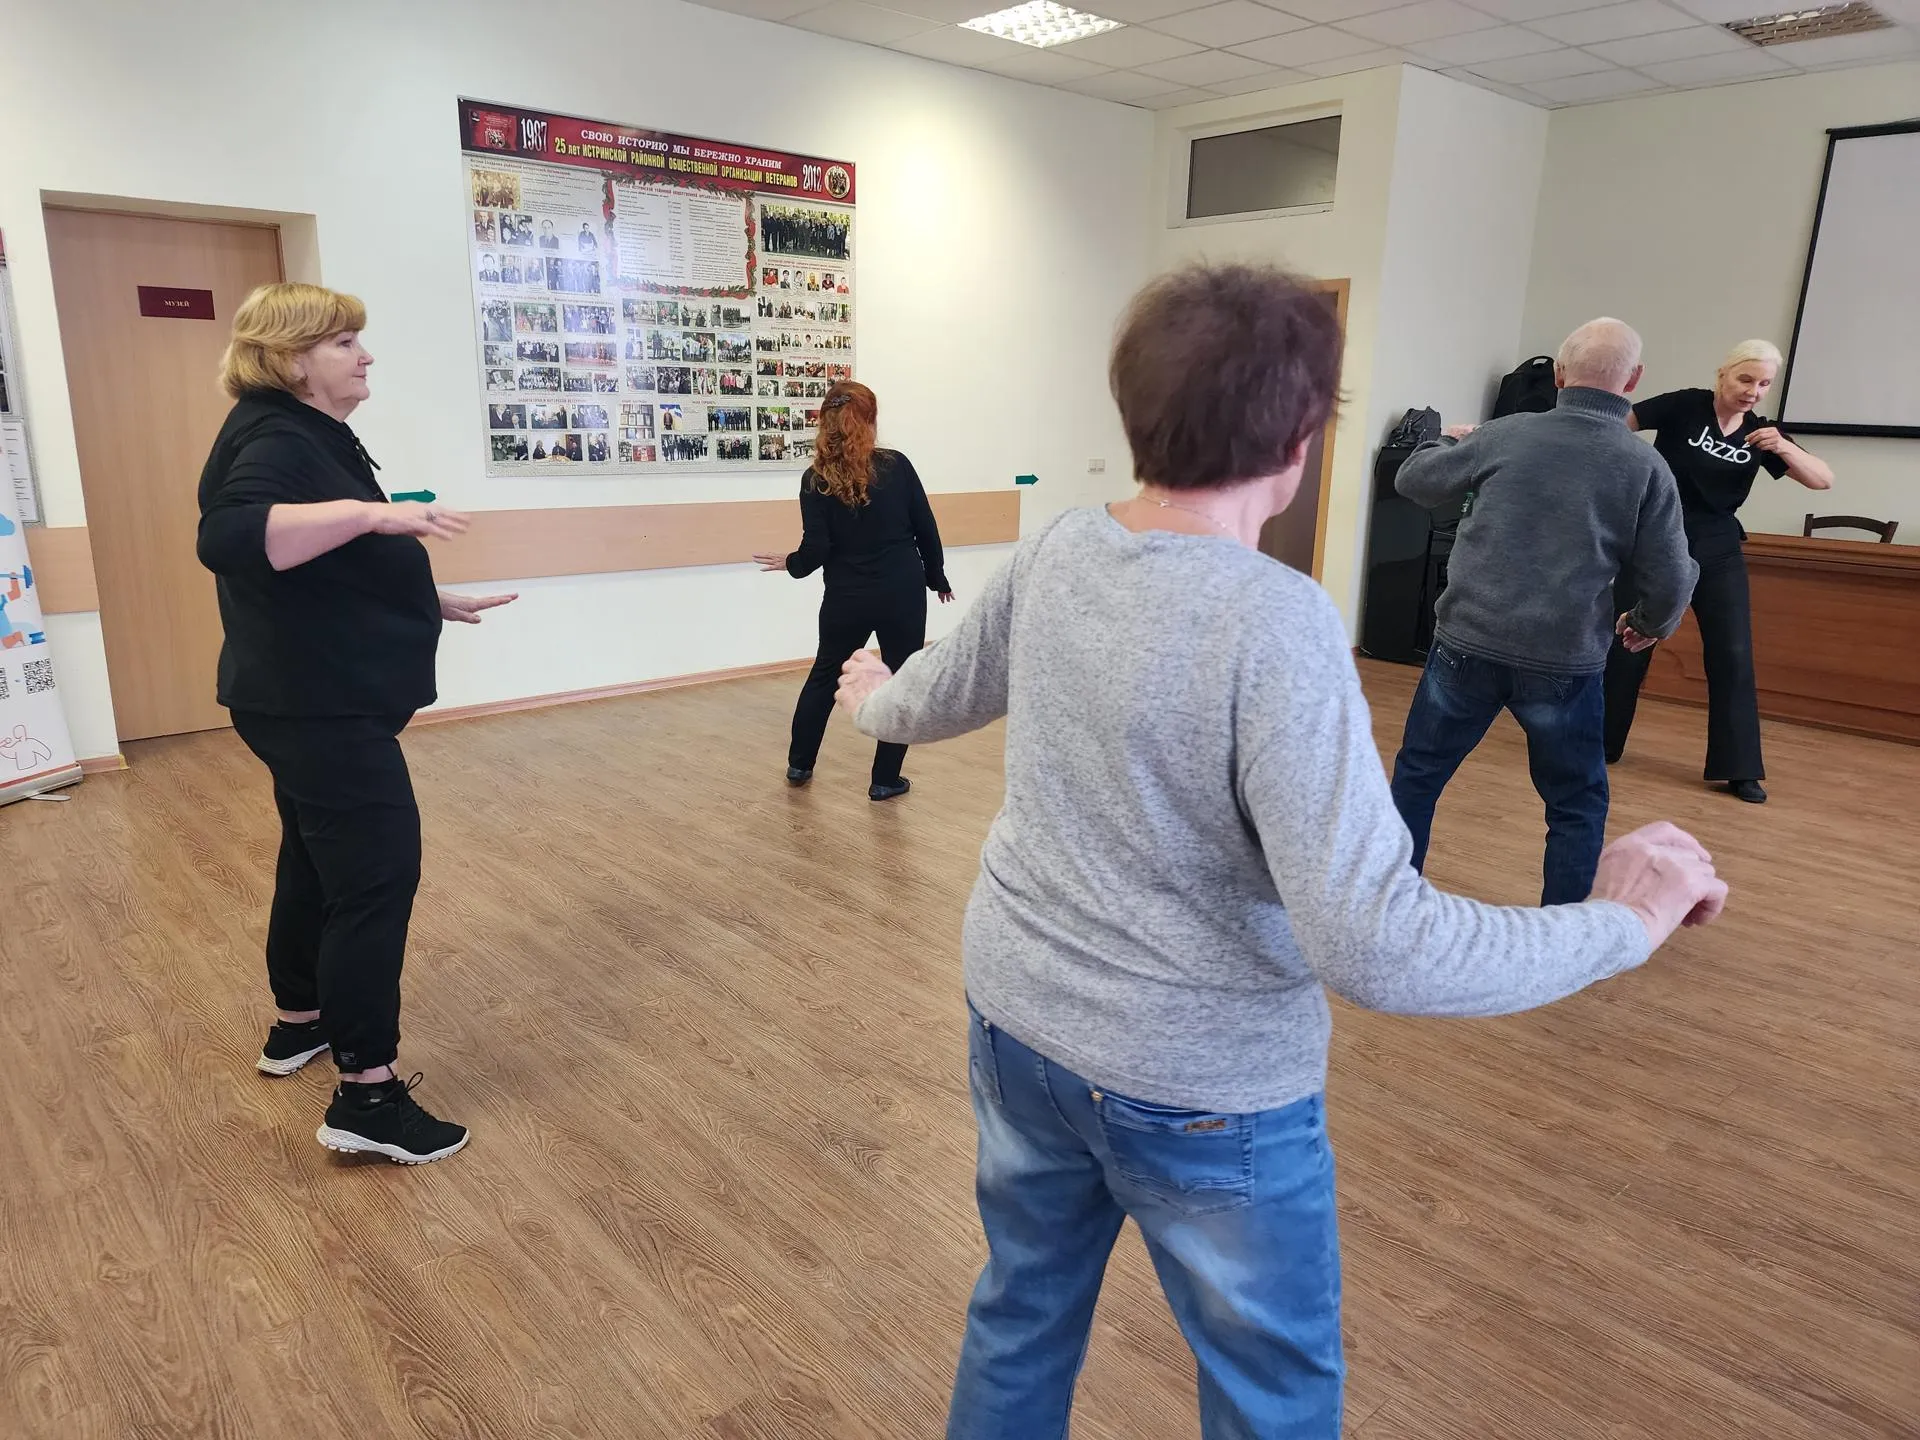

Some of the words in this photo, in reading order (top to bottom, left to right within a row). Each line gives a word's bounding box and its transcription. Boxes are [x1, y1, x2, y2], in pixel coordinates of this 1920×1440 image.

[520, 117, 548, 152] 1987
[580, 129, 614, 144] СВОЮ
[617, 135, 669, 152] ИСТОРИЮ
[673, 144, 690, 156] МЫ
[694, 148, 741, 163] БЕРЕЖНО
[744, 155, 783, 170] ХРАНИМ
[554, 136, 566, 154] 25
[568, 144, 581, 156] лет
[582, 143, 628, 163] ИСТРИНСКОЙ
[630, 151, 666, 169] РАЙОННОЙ
[668, 158, 718, 176] ОБЩЕСТВЕННОЙ
[721, 165, 763, 183] ОРГАНИЗАЦИИ
[765, 173, 798, 188] ВЕТЕРАНОВ
[802, 163, 823, 193] 2012
